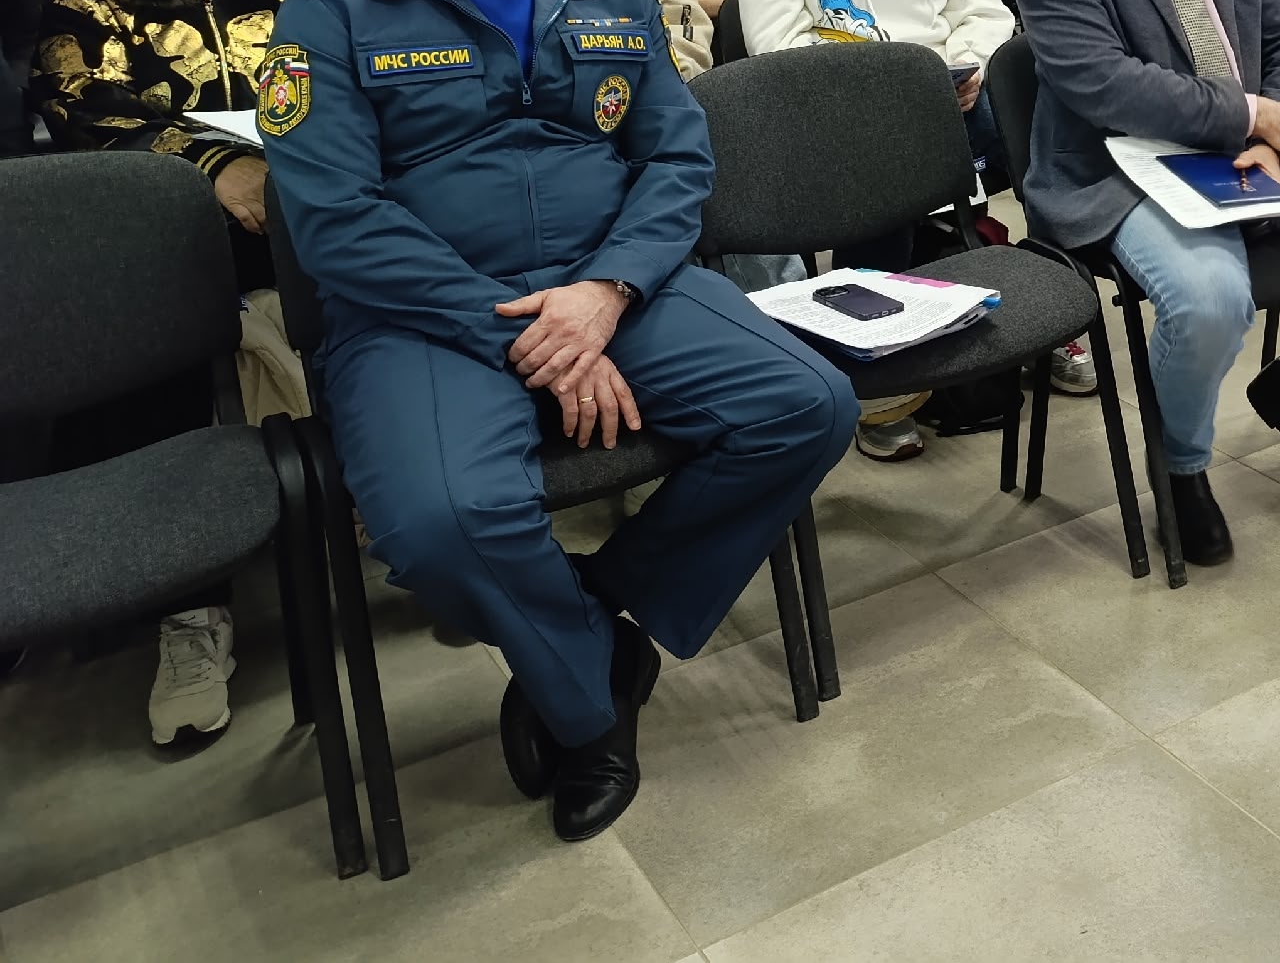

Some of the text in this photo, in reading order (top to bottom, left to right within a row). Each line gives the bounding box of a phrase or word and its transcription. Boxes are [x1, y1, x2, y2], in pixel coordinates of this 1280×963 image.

[580, 34, 646, 50] ДАРЬЯН А.О.
[276, 47, 298, 56] РОССИИ
[374, 49, 469, 70] МЧС РОССИИ
